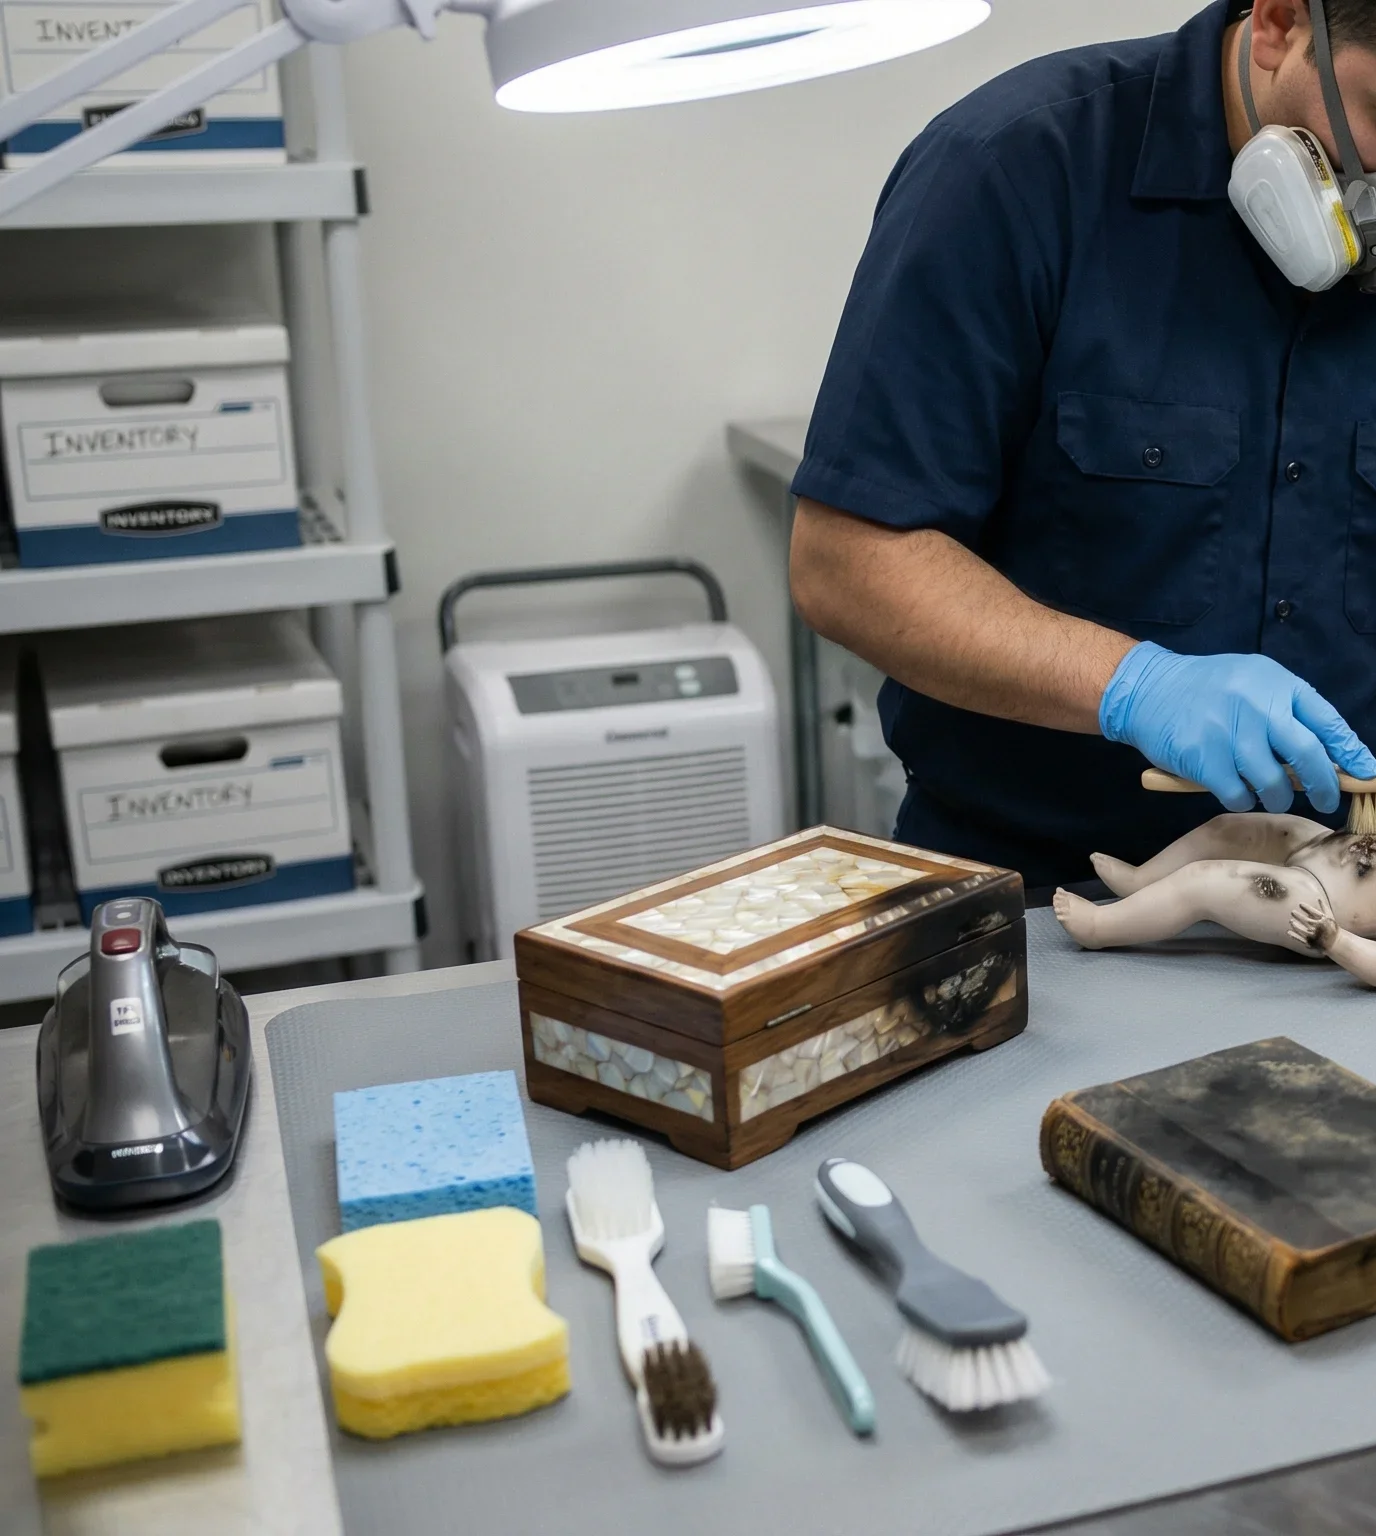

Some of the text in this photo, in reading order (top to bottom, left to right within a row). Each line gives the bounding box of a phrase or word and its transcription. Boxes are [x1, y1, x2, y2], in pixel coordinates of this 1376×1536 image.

[36, 18, 180, 44] INVENT
[45, 424, 199, 457] INVENTORY
[106, 507, 216, 528] INVENTORY
[107, 781, 253, 823] INVENTORY
